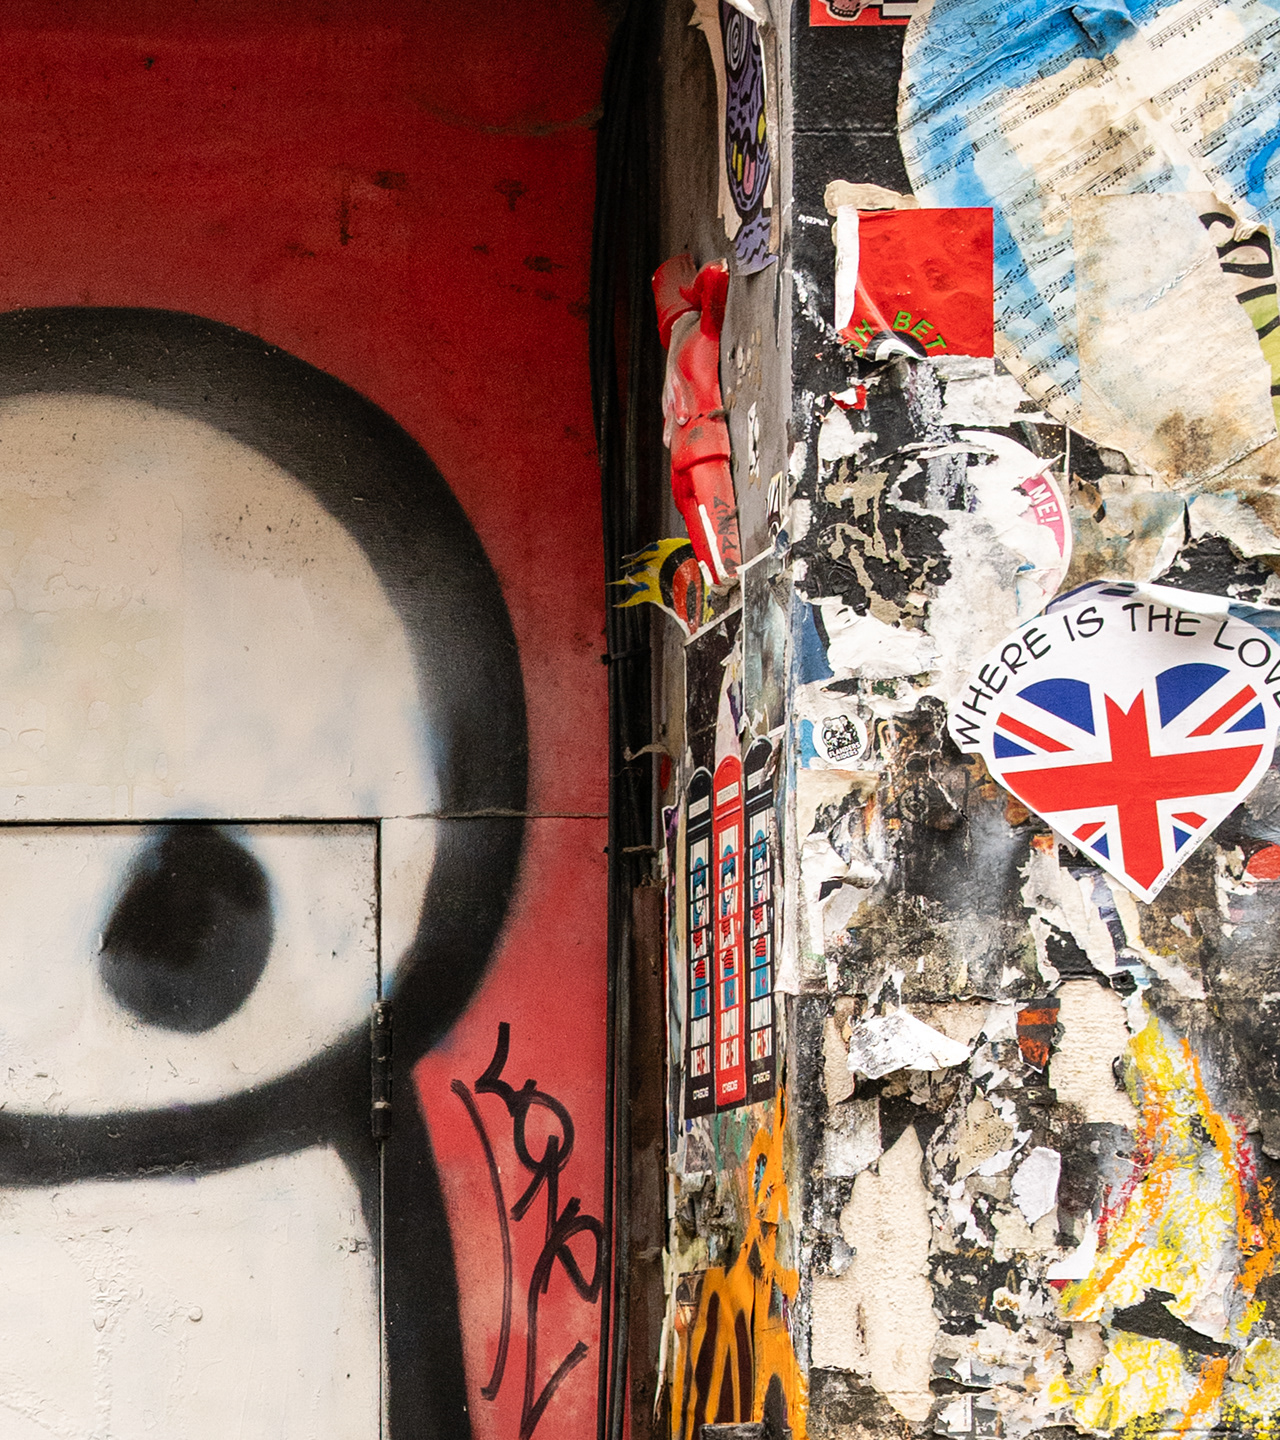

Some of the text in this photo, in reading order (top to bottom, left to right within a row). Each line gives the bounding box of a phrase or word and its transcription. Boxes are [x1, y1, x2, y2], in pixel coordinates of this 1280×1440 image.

[1028, 483, 1061, 524] ME!
[955, 627, 1052, 746] WHERE
[1063, 606, 1104, 642] IS
[1122, 602, 1201, 637] THE
